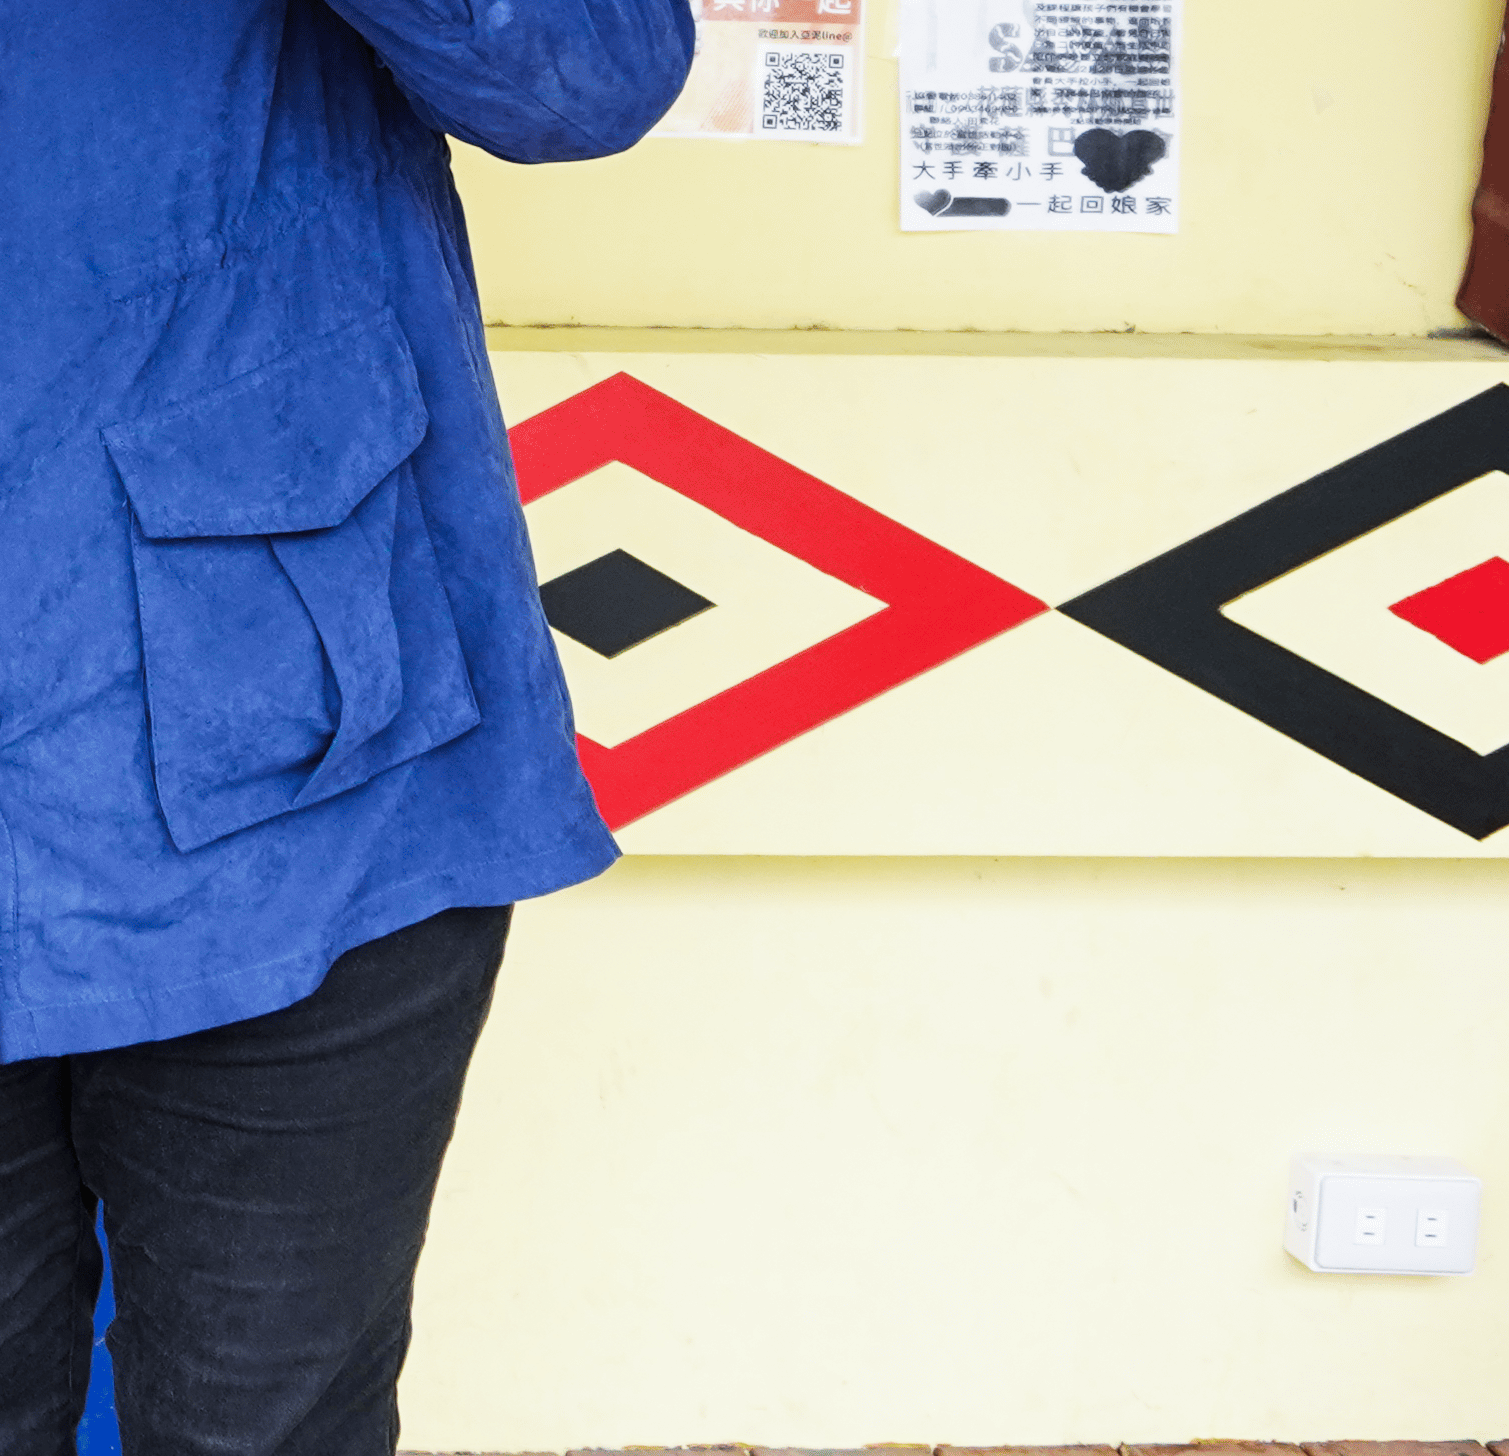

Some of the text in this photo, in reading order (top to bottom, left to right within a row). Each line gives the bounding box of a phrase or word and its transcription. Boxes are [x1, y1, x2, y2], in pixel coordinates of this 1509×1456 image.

[912, 160, 1064, 181] 大手牽小手
[1016, 194, 1172, 215] 一起回娘家
